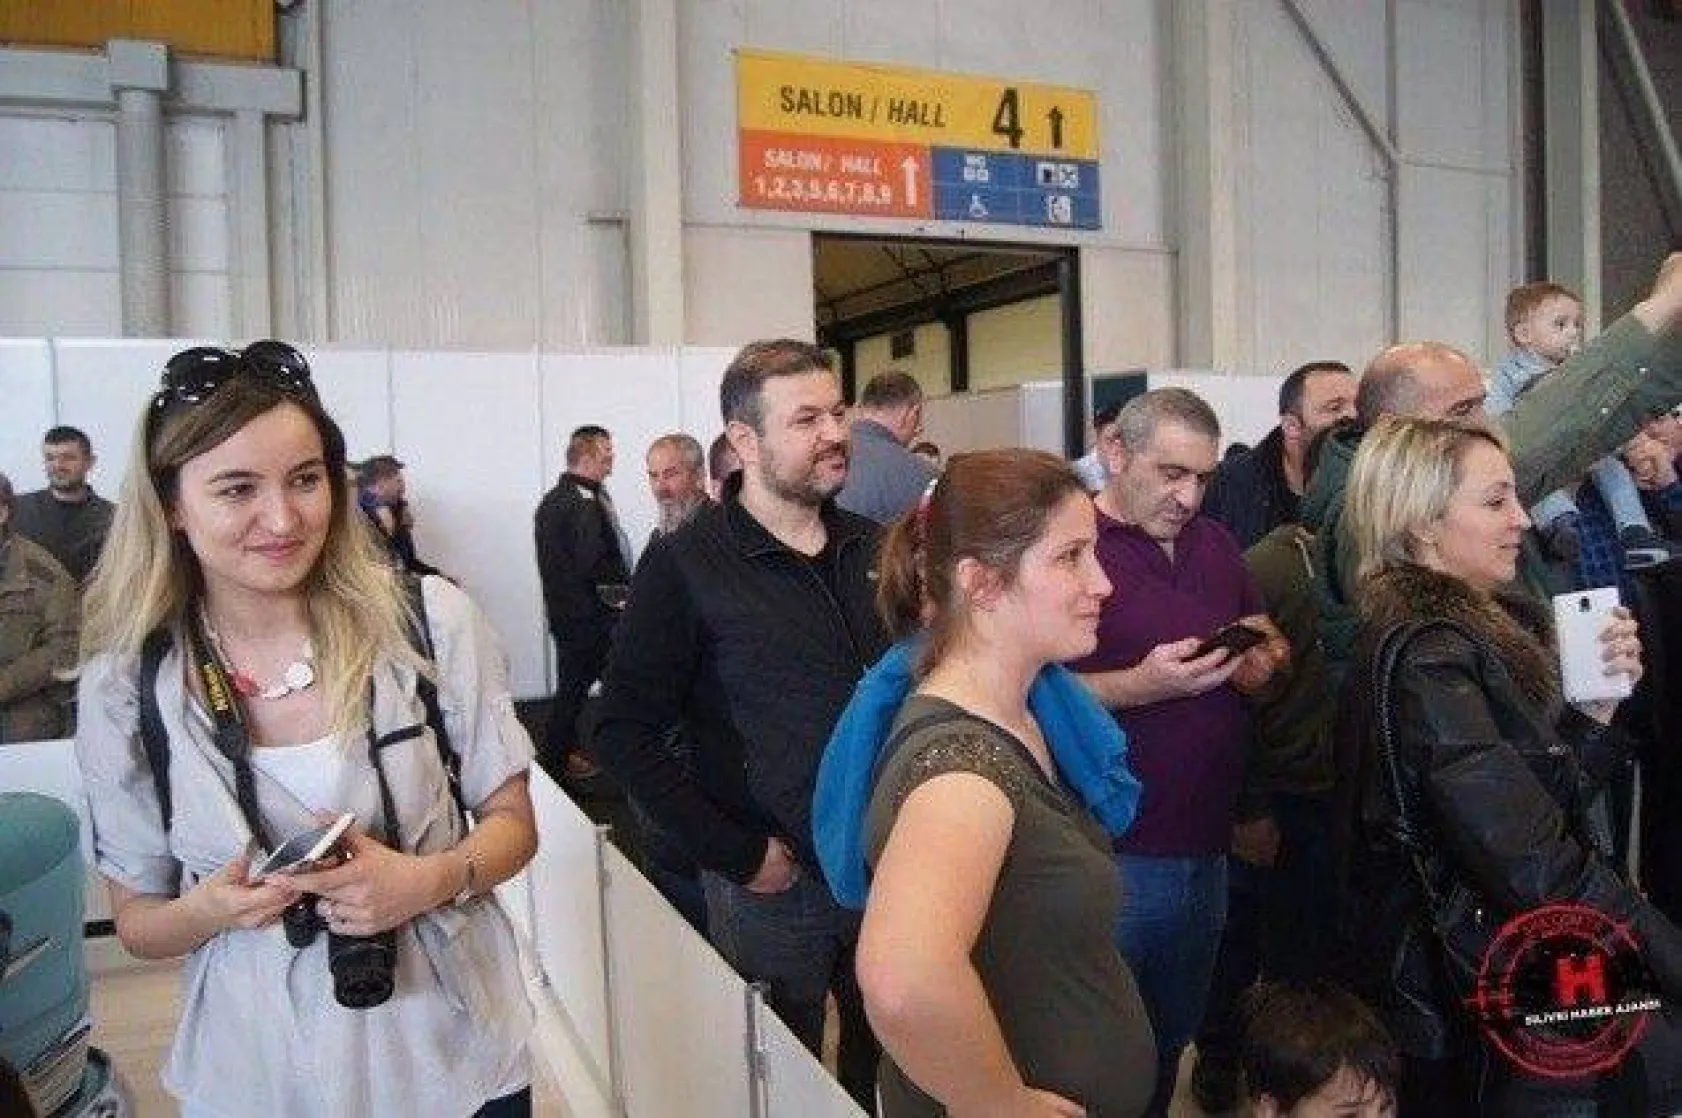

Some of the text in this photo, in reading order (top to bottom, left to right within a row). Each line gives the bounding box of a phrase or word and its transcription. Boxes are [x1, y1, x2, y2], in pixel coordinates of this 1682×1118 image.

[780, 84, 862, 118] SALON
[887, 97, 947, 127] HALL
[993, 87, 1025, 149] 4
[764, 148, 822, 170] SALON
